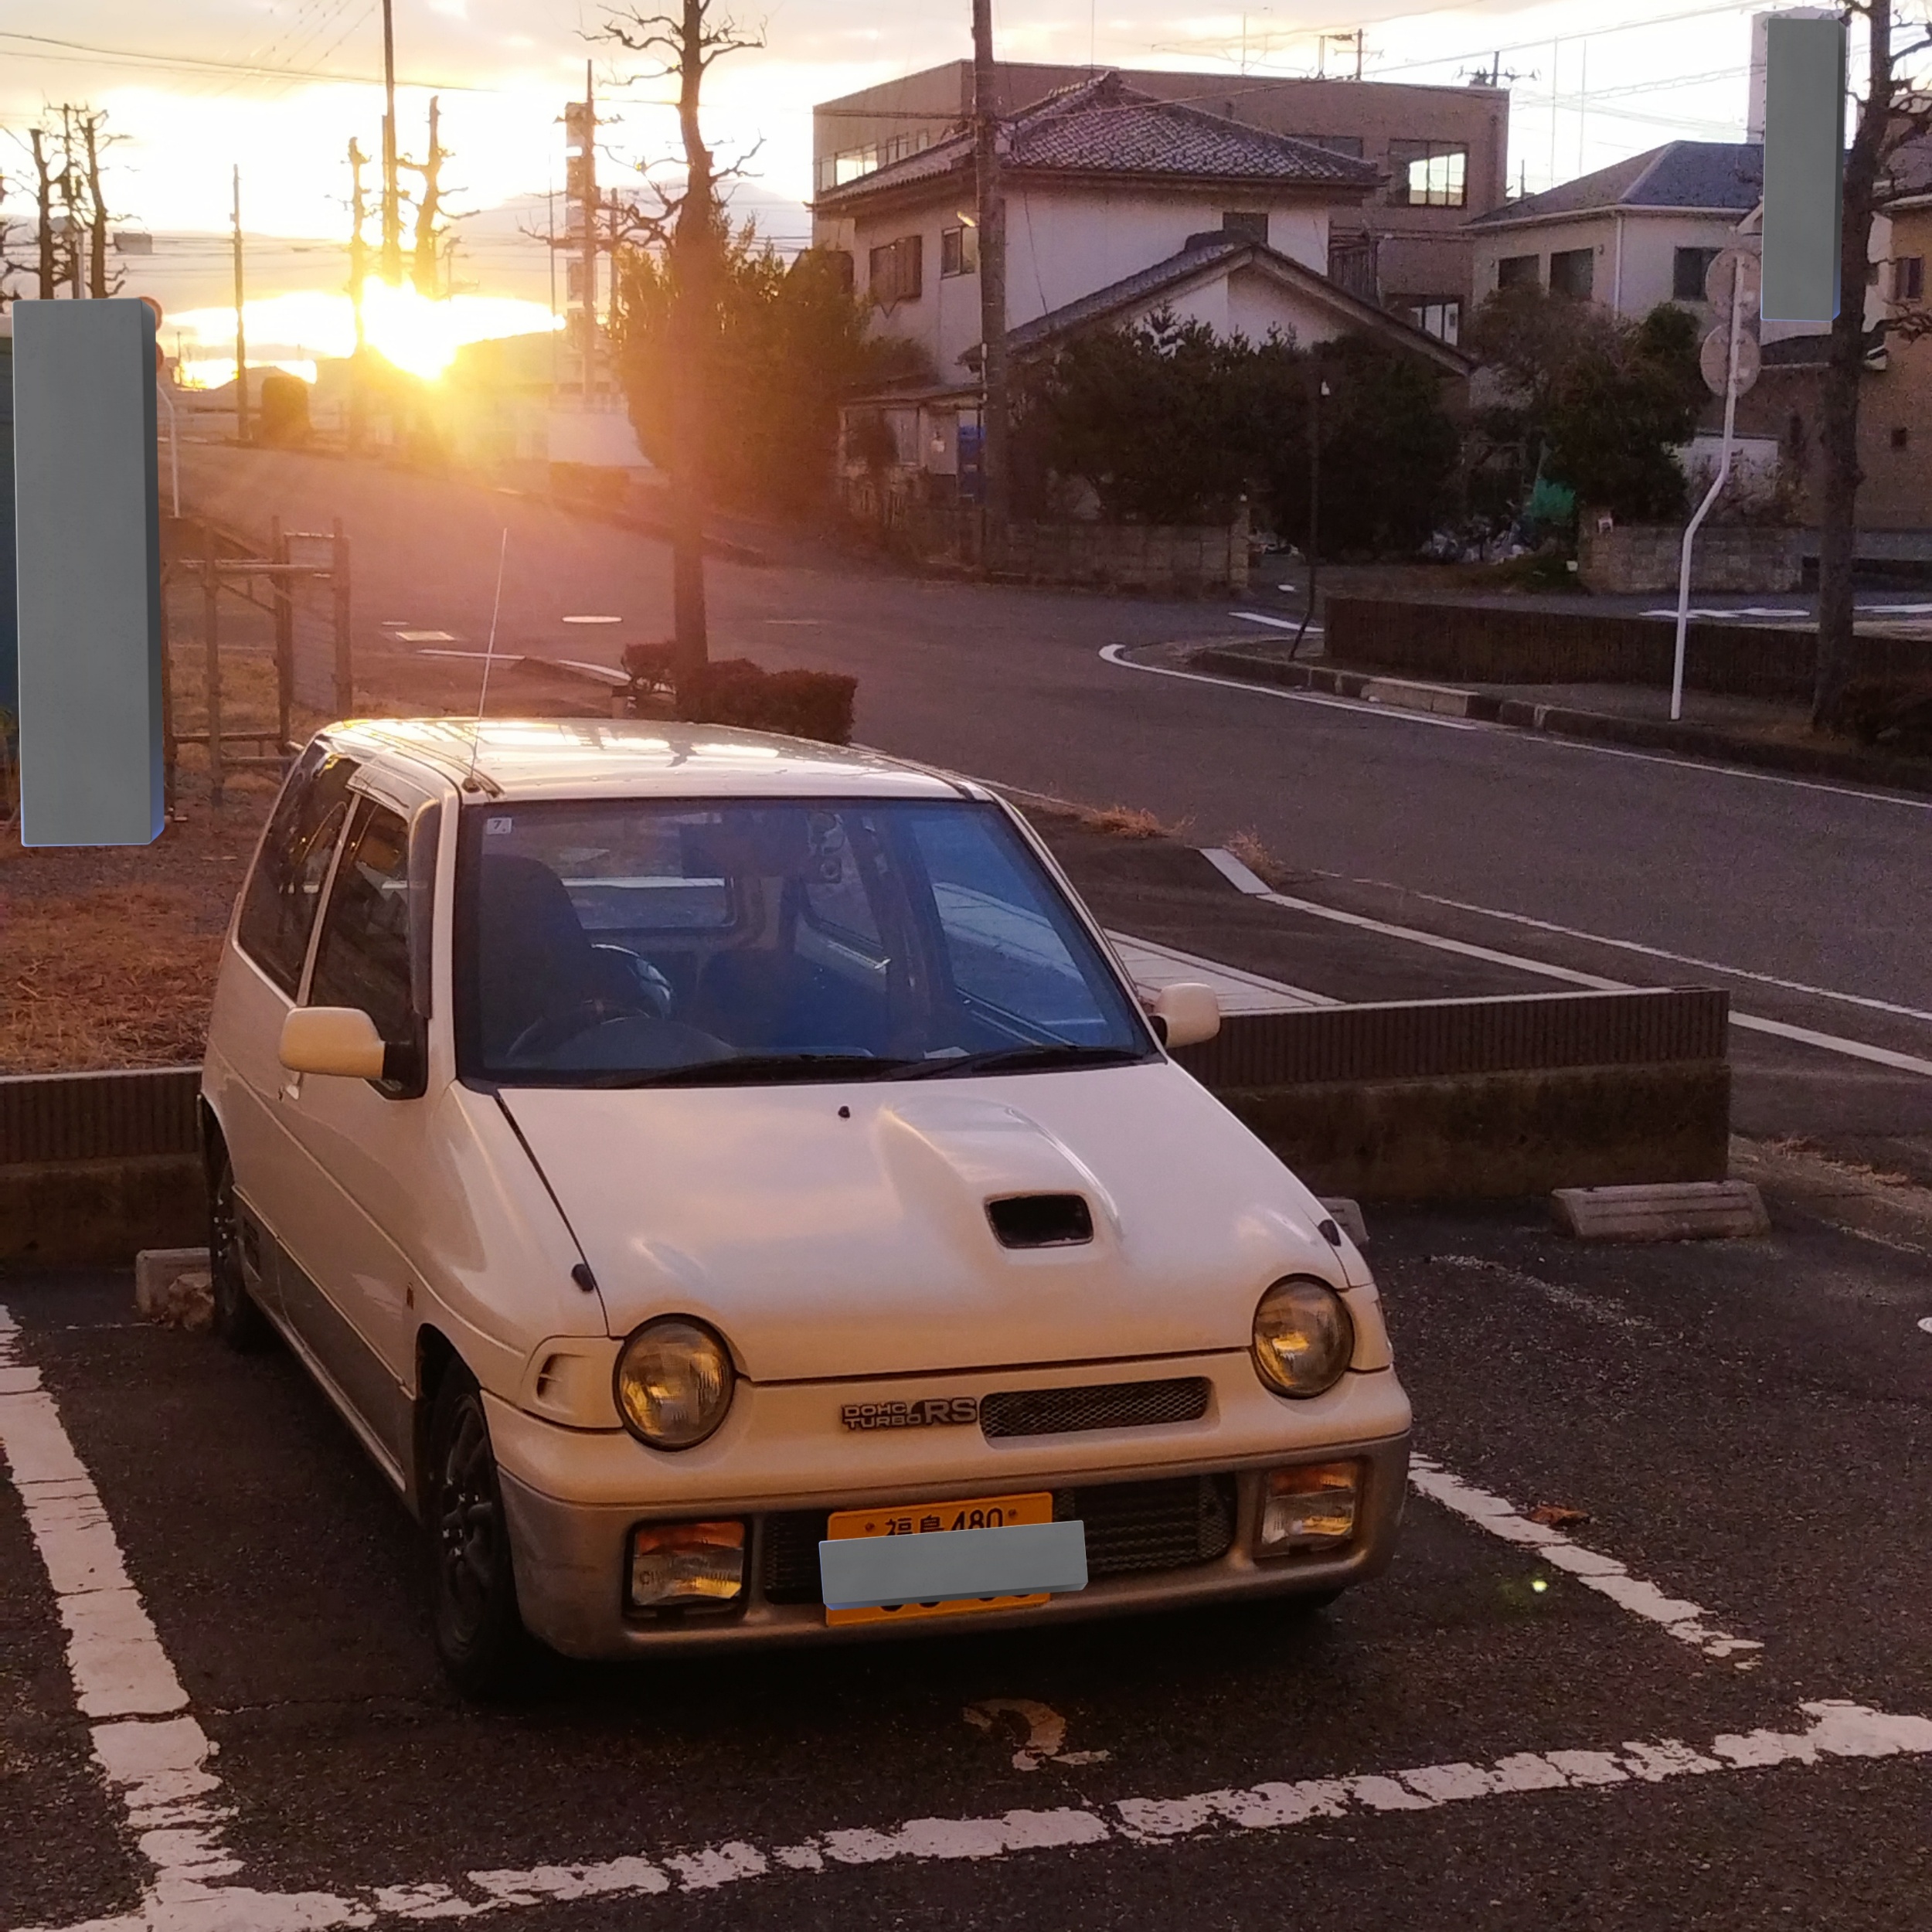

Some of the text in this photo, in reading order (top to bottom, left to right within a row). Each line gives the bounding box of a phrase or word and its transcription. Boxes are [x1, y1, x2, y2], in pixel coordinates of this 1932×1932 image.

[844, 1403, 907, 1417] DOHC
[923, 1397, 978, 1424] RS
[844, 1413, 921, 1429] TURBO
[951, 1507, 1004, 1531] 480
